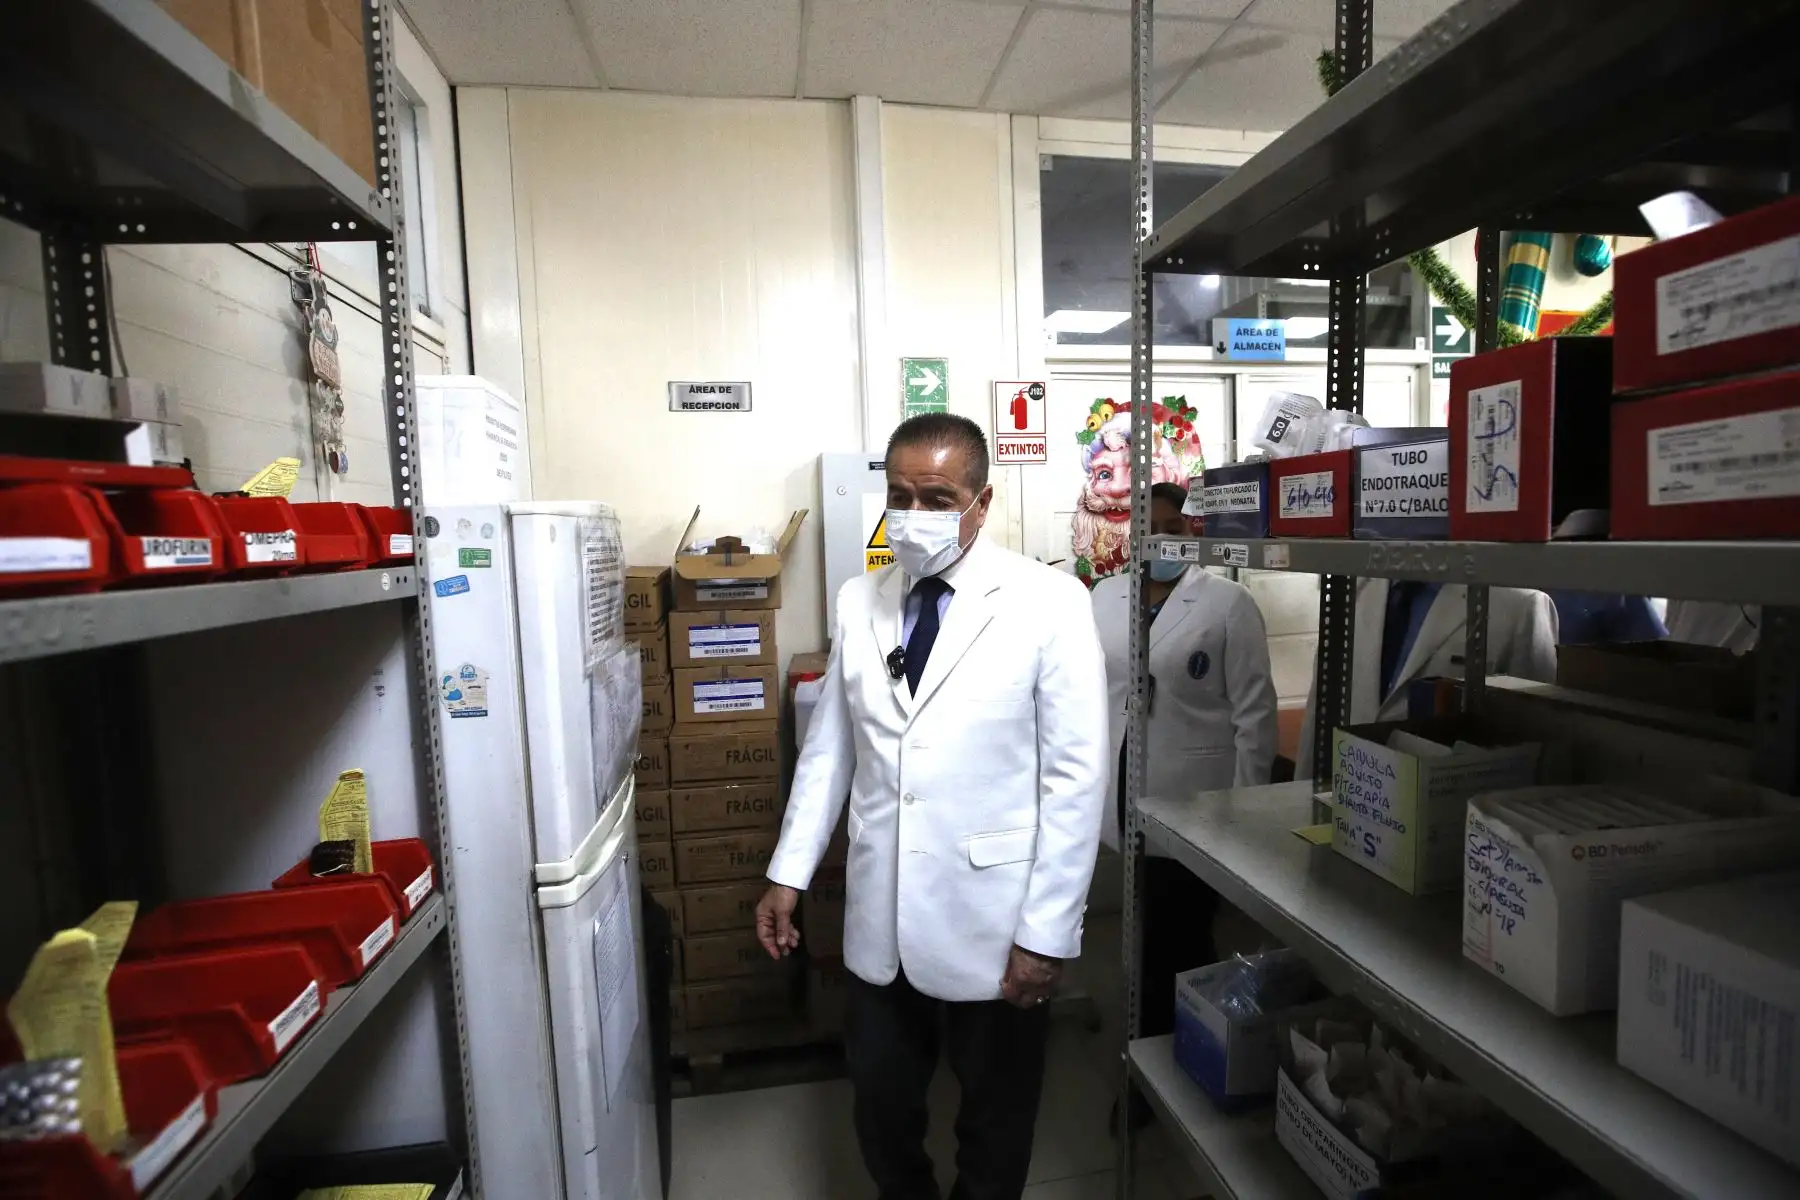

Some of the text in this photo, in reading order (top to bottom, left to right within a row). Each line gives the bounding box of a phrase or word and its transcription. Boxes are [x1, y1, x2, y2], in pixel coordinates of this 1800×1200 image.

[1266, 328, 1279, 337] DE
[688, 384, 732, 394] ÁREA DE
[682, 402, 740, 410] RECEPCION
[999, 443, 1045, 455] EXTINTOR
[1391, 450, 1428, 467] TUBO
[1362, 473, 1449, 491] ENDOTRAQUE
[1230, 497, 1256, 506] NEONATAL
[725, 745, 776, 765] FRÁGIL
[725, 796, 774, 815] FRÁGIL
[1588, 845, 1607, 858] BD
